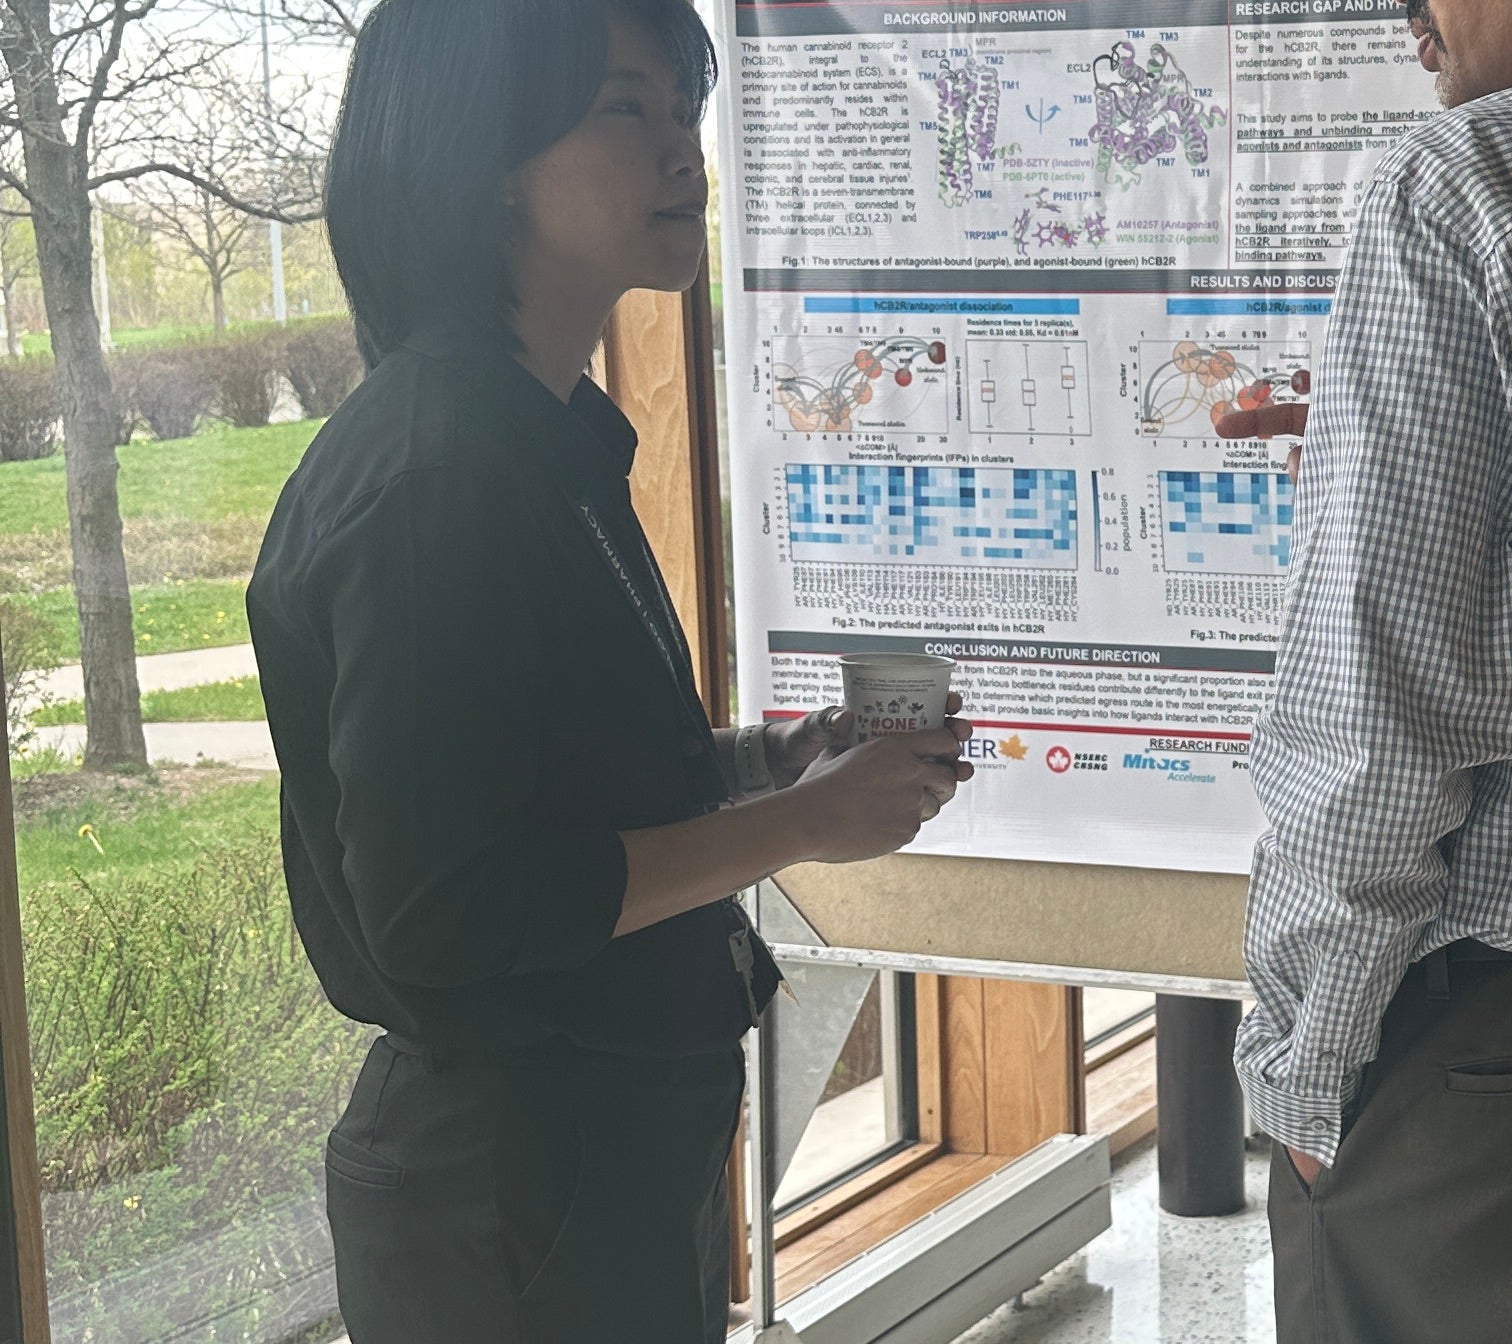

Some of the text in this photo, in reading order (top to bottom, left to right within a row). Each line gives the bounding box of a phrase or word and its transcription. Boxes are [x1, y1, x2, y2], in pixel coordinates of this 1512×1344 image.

[1236, 2, 1309, 16] RESEARCH
[1313, 0, 1341, 13] GAP
[1345, 0, 1373, 11] AND
[884, 10, 1066, 24] BACKGROUND INFORMATION
[1126, 31, 1145, 39] TM4
[1160, 32, 1179, 41] TM3
[1236, 26, 1385, 41] Despite numerous compounds
[804, 41, 895, 51] cannabinoid receptor
[976, 37, 996, 46] MPR
[949, 48, 968, 57] TM3
[985, 56, 1003, 65] TM2
[1236, 58, 1302, 70] understanding
[742, 68, 818, 79] endocannabinoid
[1067, 64, 1090, 73] ECL2
[1163, 75, 1183, 83] MPR
[1236, 72, 1289, 81] interactions
[853, 81, 907, 90] cannabinoids
[1002, 81, 1020, 89] TM1
[1194, 89, 1212, 98] TM2
[773, 95, 873, 106] predominantly resides
[1074, 95, 1092, 104] TM5
[744, 120, 909, 133] upregulated pathophysiological
[1237, 126, 1372, 138] pathways unbinding
[744, 135, 867, 144] conditions activation
[1069, 138, 1088, 147] TM6
[1237, 140, 1363, 152] agonists antagonists
[761, 148, 809, 157] associated
[978, 163, 995, 171] TM7
[1052, 159, 1094, 168] (inactive)
[1157, 158, 1175, 167] TM7
[809, 174, 844, 183] cerebral
[1192, 169, 1210, 178] TM1
[821, 187, 914, 196] seven-transmembrane
[1250, 181, 1346, 193] combined approach
[974, 190, 992, 199] TM6
[855, 201, 898, 209] connected
[1235, 196, 1343, 207] dynamics simulations
[780, 214, 834, 222] extracellular
[1235, 209, 1337, 220] sampling approaches
[1161, 220, 1219, 231] (Antagonist)
[746, 227, 798, 235] intracellular
[1117, 234, 1137, 243] WIN
[1176, 234, 1219, 244] (Agonist)
[1235, 250, 1272, 261] binding
[812, 257, 830, 265] The
[833, 257, 880, 265] structures
[895, 257, 972, 267] antagonist-bound
[1034, 257, 1101, 267] agonist-bound
[1105, 257, 1139, 267] (green)
[1142, 257, 1176, 265] hCB2R
[1191, 276, 1250, 287] RESULTS
[1253, 276, 1282, 287] AND
[874, 301, 1013, 311] hCB2R/antagonist dissociation
[849, 453, 1014, 464] Interaction fingerprints (IFPs) clusters
[1224, 461, 1268, 469] Interaction
[1123, 494, 1131, 551] population
[859, 618, 875, 628] The
[879, 620, 921, 631] predicted
[924, 622, 975, 632] antagonist
[978, 624, 999, 632] exits
[1013, 624, 1044, 633] hCB2R
[1219, 632, 1236, 641] The
[1239, 632, 1281, 643] predicte
[925, 643, 1160, 663] CONCLUSION AND FUTURE DIRECTION
[1154, 673, 1245, 686] significant proportion
[977, 679, 1187, 698] Various bottleneck residues contribute differently
[983, 692, 1261, 713] determine predicted energetically
[998, 706, 1197, 722] provide insights ligands interact
[872, 718, 916, 730] #ONE
[1150, 738, 1212, 751] RESEARCH
[1123, 748, 1190, 772] Mitacs
[1074, 762, 1108, 771] CRSNG
[1168, 772, 1215, 783] Accelerate
